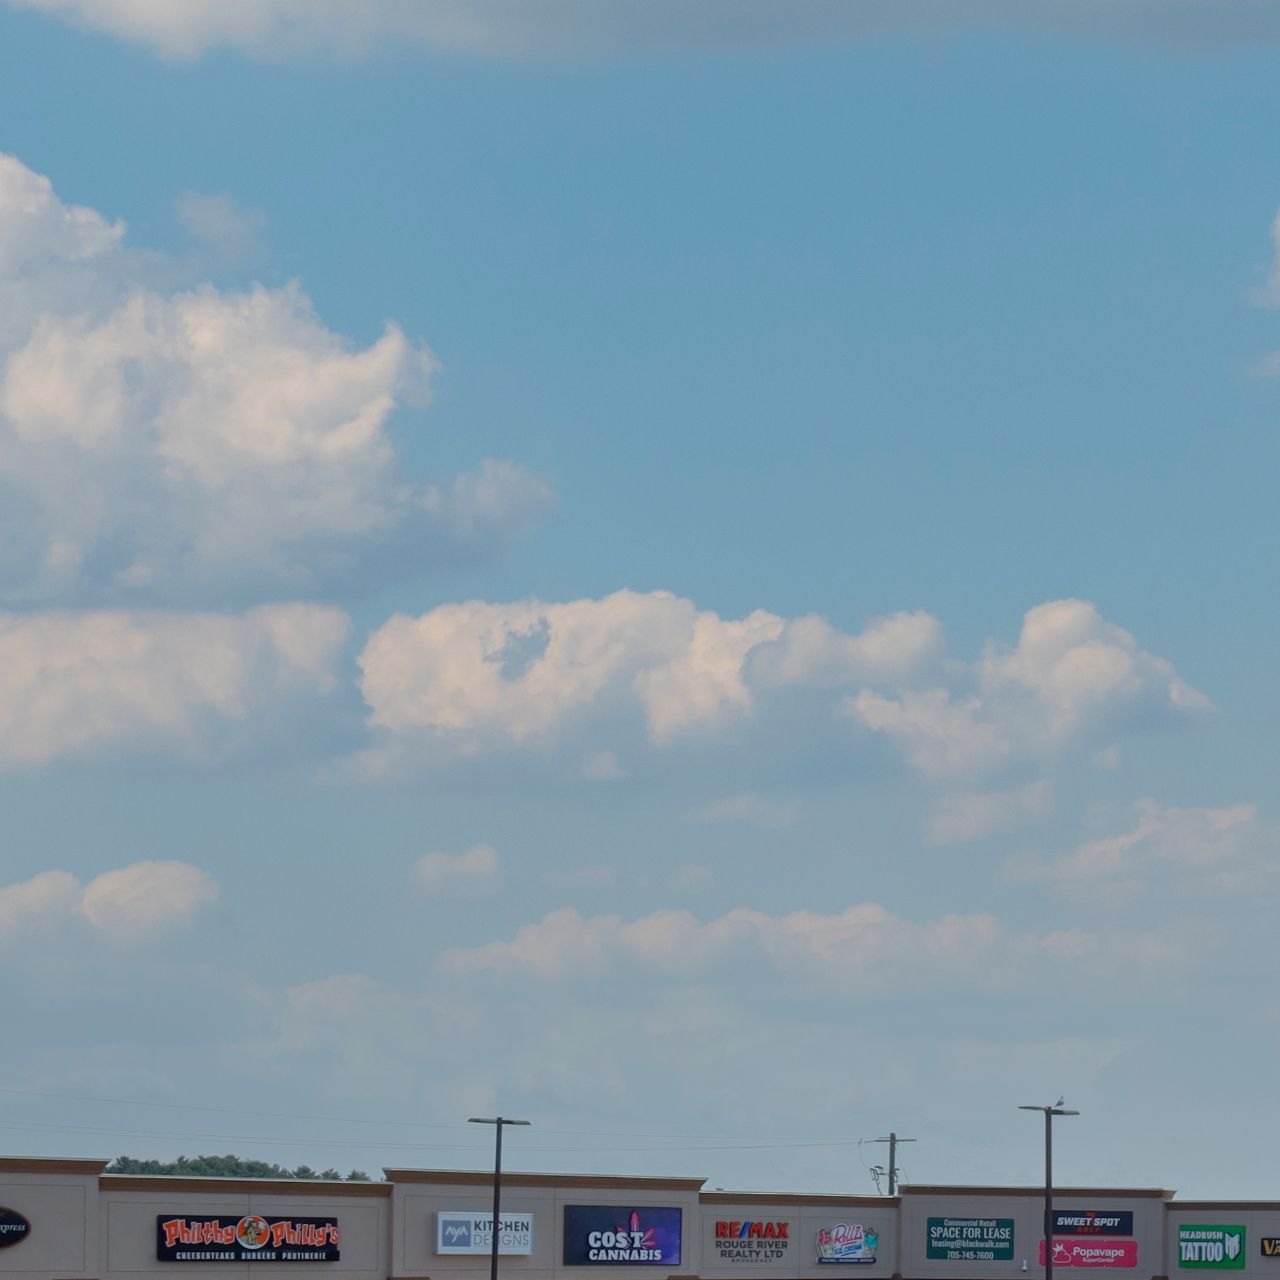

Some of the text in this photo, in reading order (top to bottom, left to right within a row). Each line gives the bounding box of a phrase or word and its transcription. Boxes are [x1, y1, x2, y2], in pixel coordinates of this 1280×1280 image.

[944, 1219, 978, 1227] Commercial
[1056, 1217, 1120, 1227] SWEET SPOT
[162, 1219, 340, 1247] Philthy Philly's
[715, 1221, 789, 1239] RE/MAX
[930, 1227, 1011, 1239] SPACE FOR LEASE
[1179, 1230, 1223, 1239] HEADRUSH
[588, 1231, 644, 1249] COST
[715, 1240, 788, 1249] ROUGE RIVER
[588, 1249, 662, 1261] CANNABIS
[720, 1249, 783, 1258] REALTY LTD
[946, 1250, 994, 1260] 705-745-7600
[1072, 1247, 1125, 1258] Popavape
[1180, 1241, 1223, 1262] TATTOO
